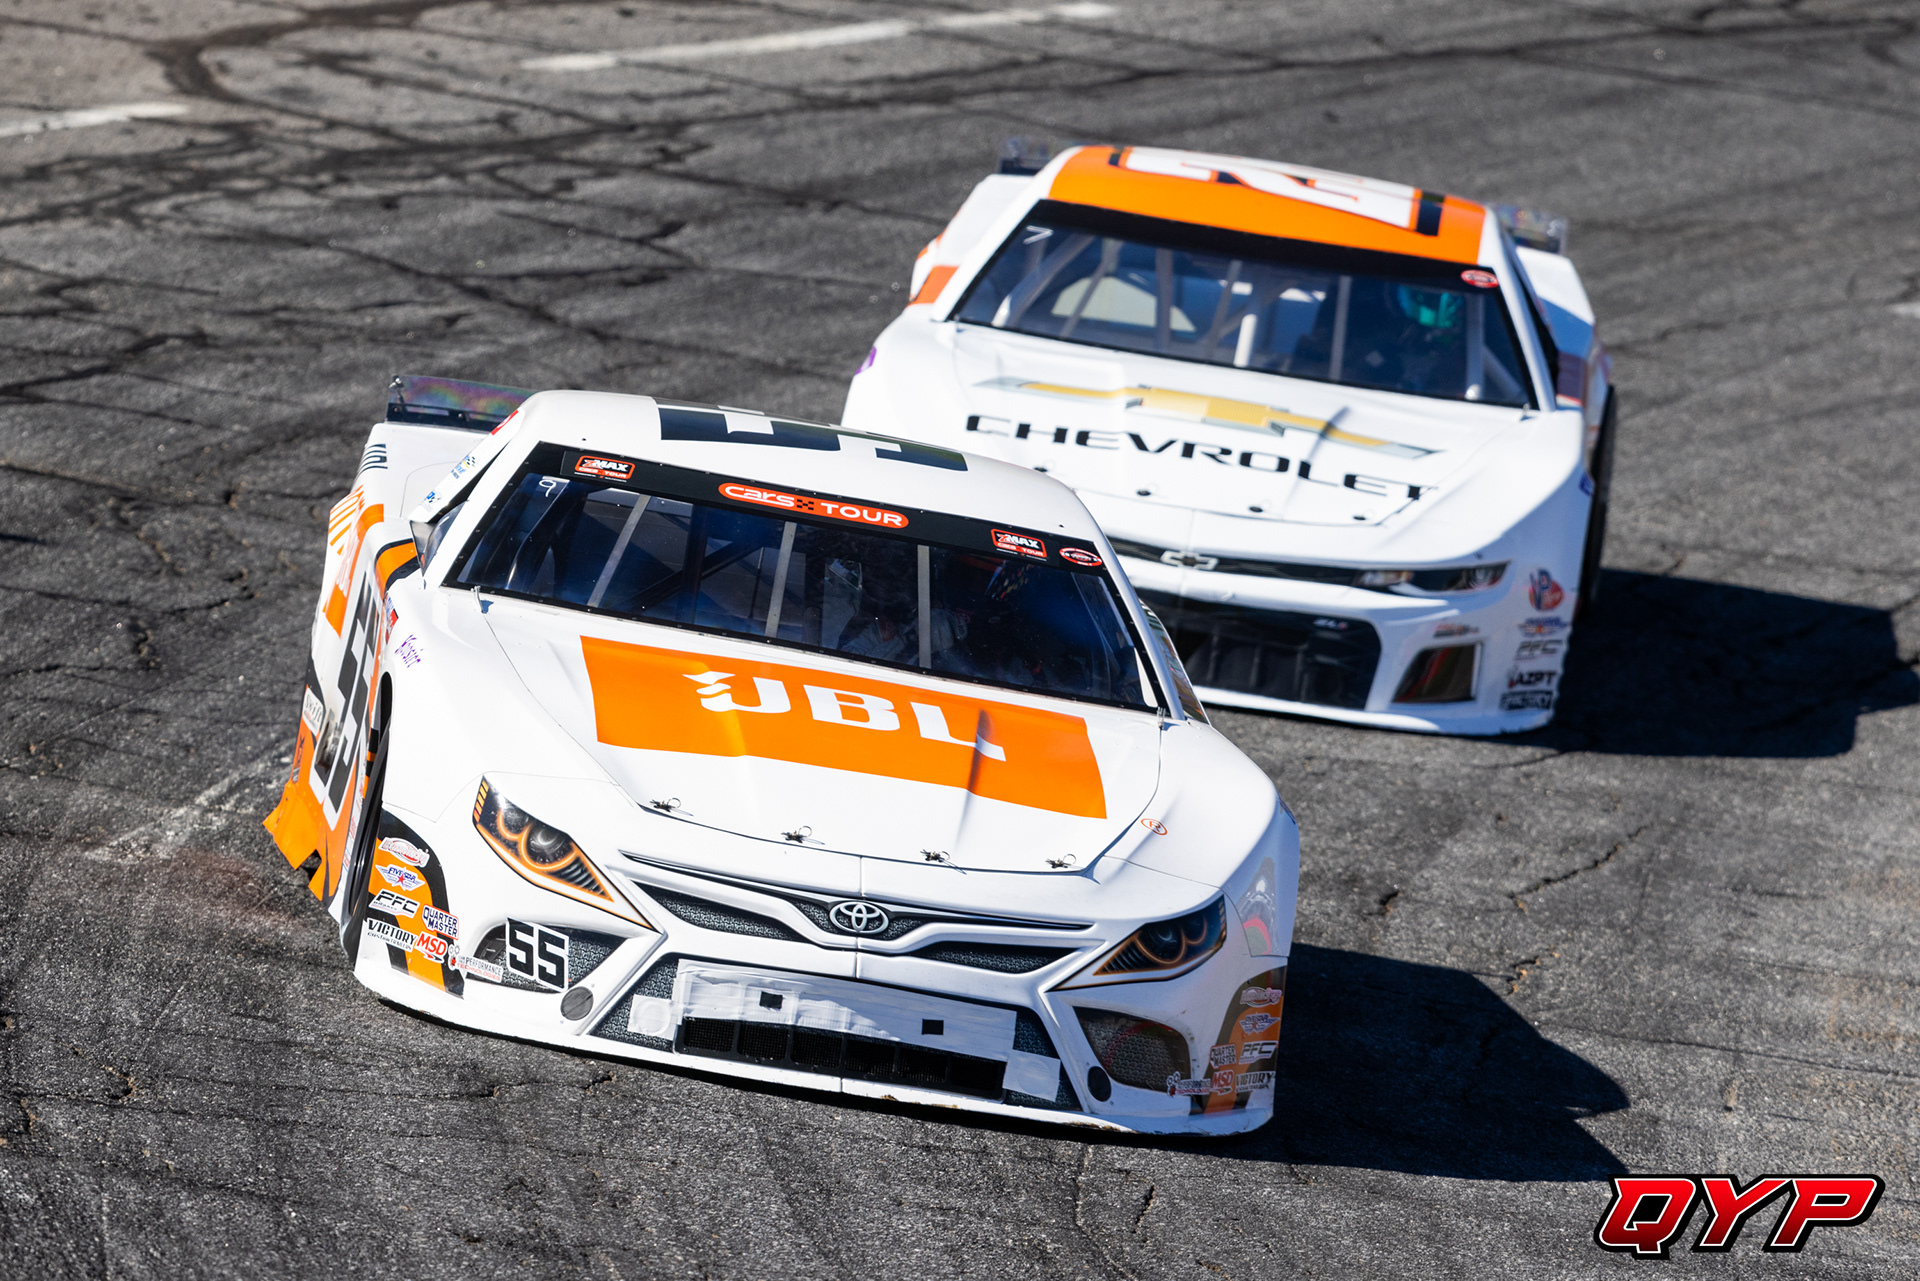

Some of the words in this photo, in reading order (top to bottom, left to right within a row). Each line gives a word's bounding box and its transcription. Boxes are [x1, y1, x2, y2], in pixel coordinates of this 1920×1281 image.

[966, 415, 1438, 499] CHEVROLET
[821, 502, 902, 526] TOUR
[376, 890, 418, 914] PFC
[422, 906, 458, 928] QUARTER
[427, 918, 458, 938] MASTER
[368, 919, 417, 945] VICTORY
[416, 932, 447, 956] MSD
[509, 917, 565, 989] 55
[465, 956, 502, 976] PERFORMANCE
[1241, 1042, 1277, 1056] PFC
[1211, 1071, 1234, 1089] MSD
